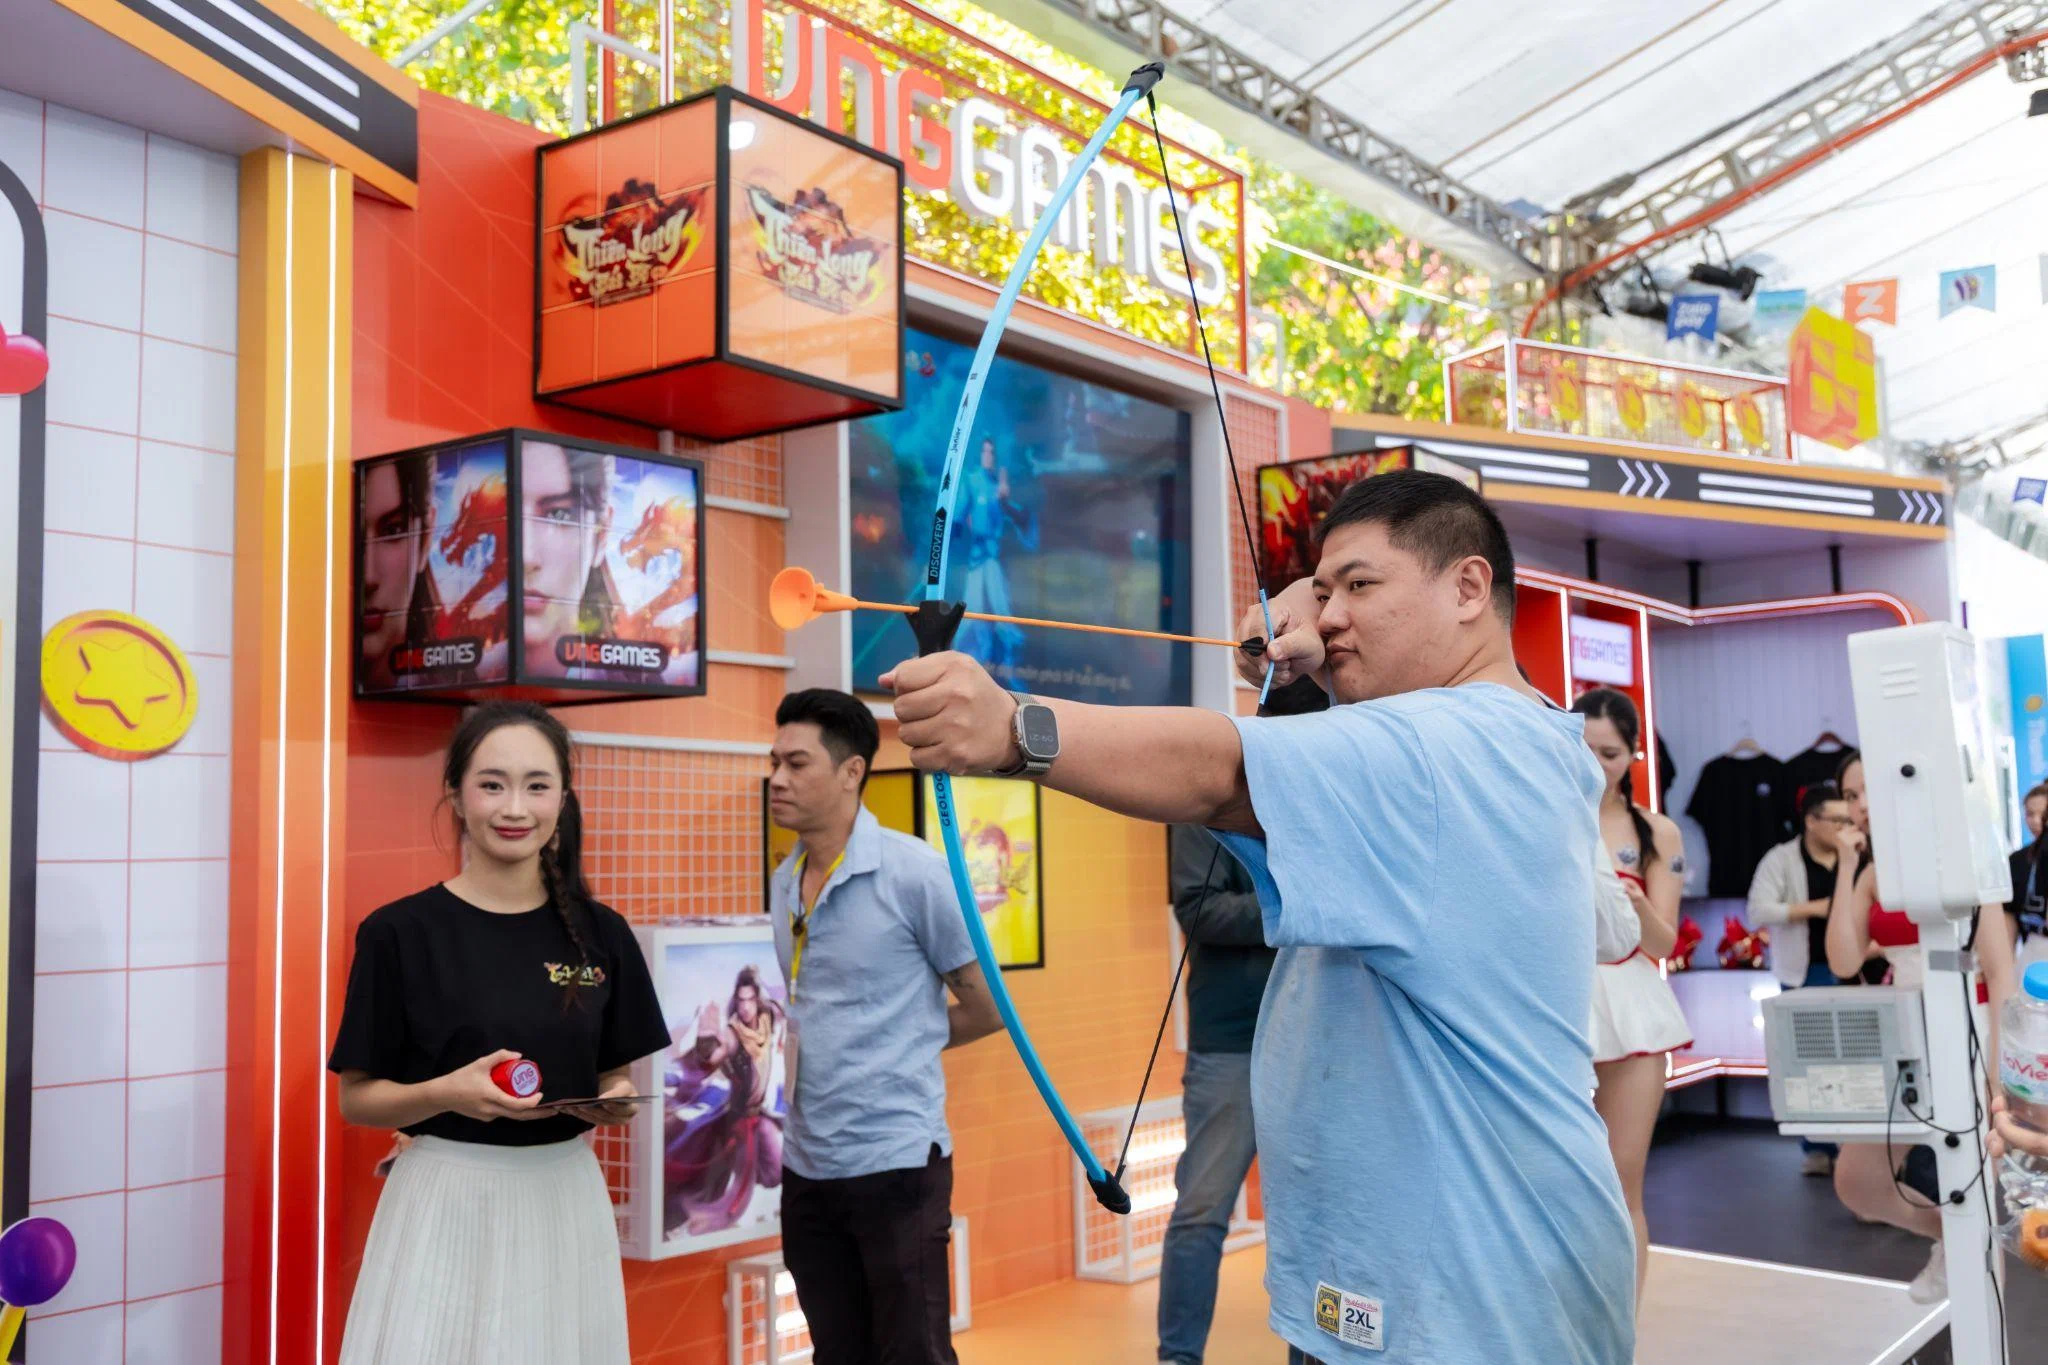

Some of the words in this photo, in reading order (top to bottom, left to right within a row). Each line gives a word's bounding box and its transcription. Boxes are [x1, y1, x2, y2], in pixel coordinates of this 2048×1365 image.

[1856, 286, 1885, 316] Z
[929, 516, 945, 578] DISCOVERY
[934, 770, 951, 827] GEOLOG
[1345, 1307, 1376, 1331] 2XL
